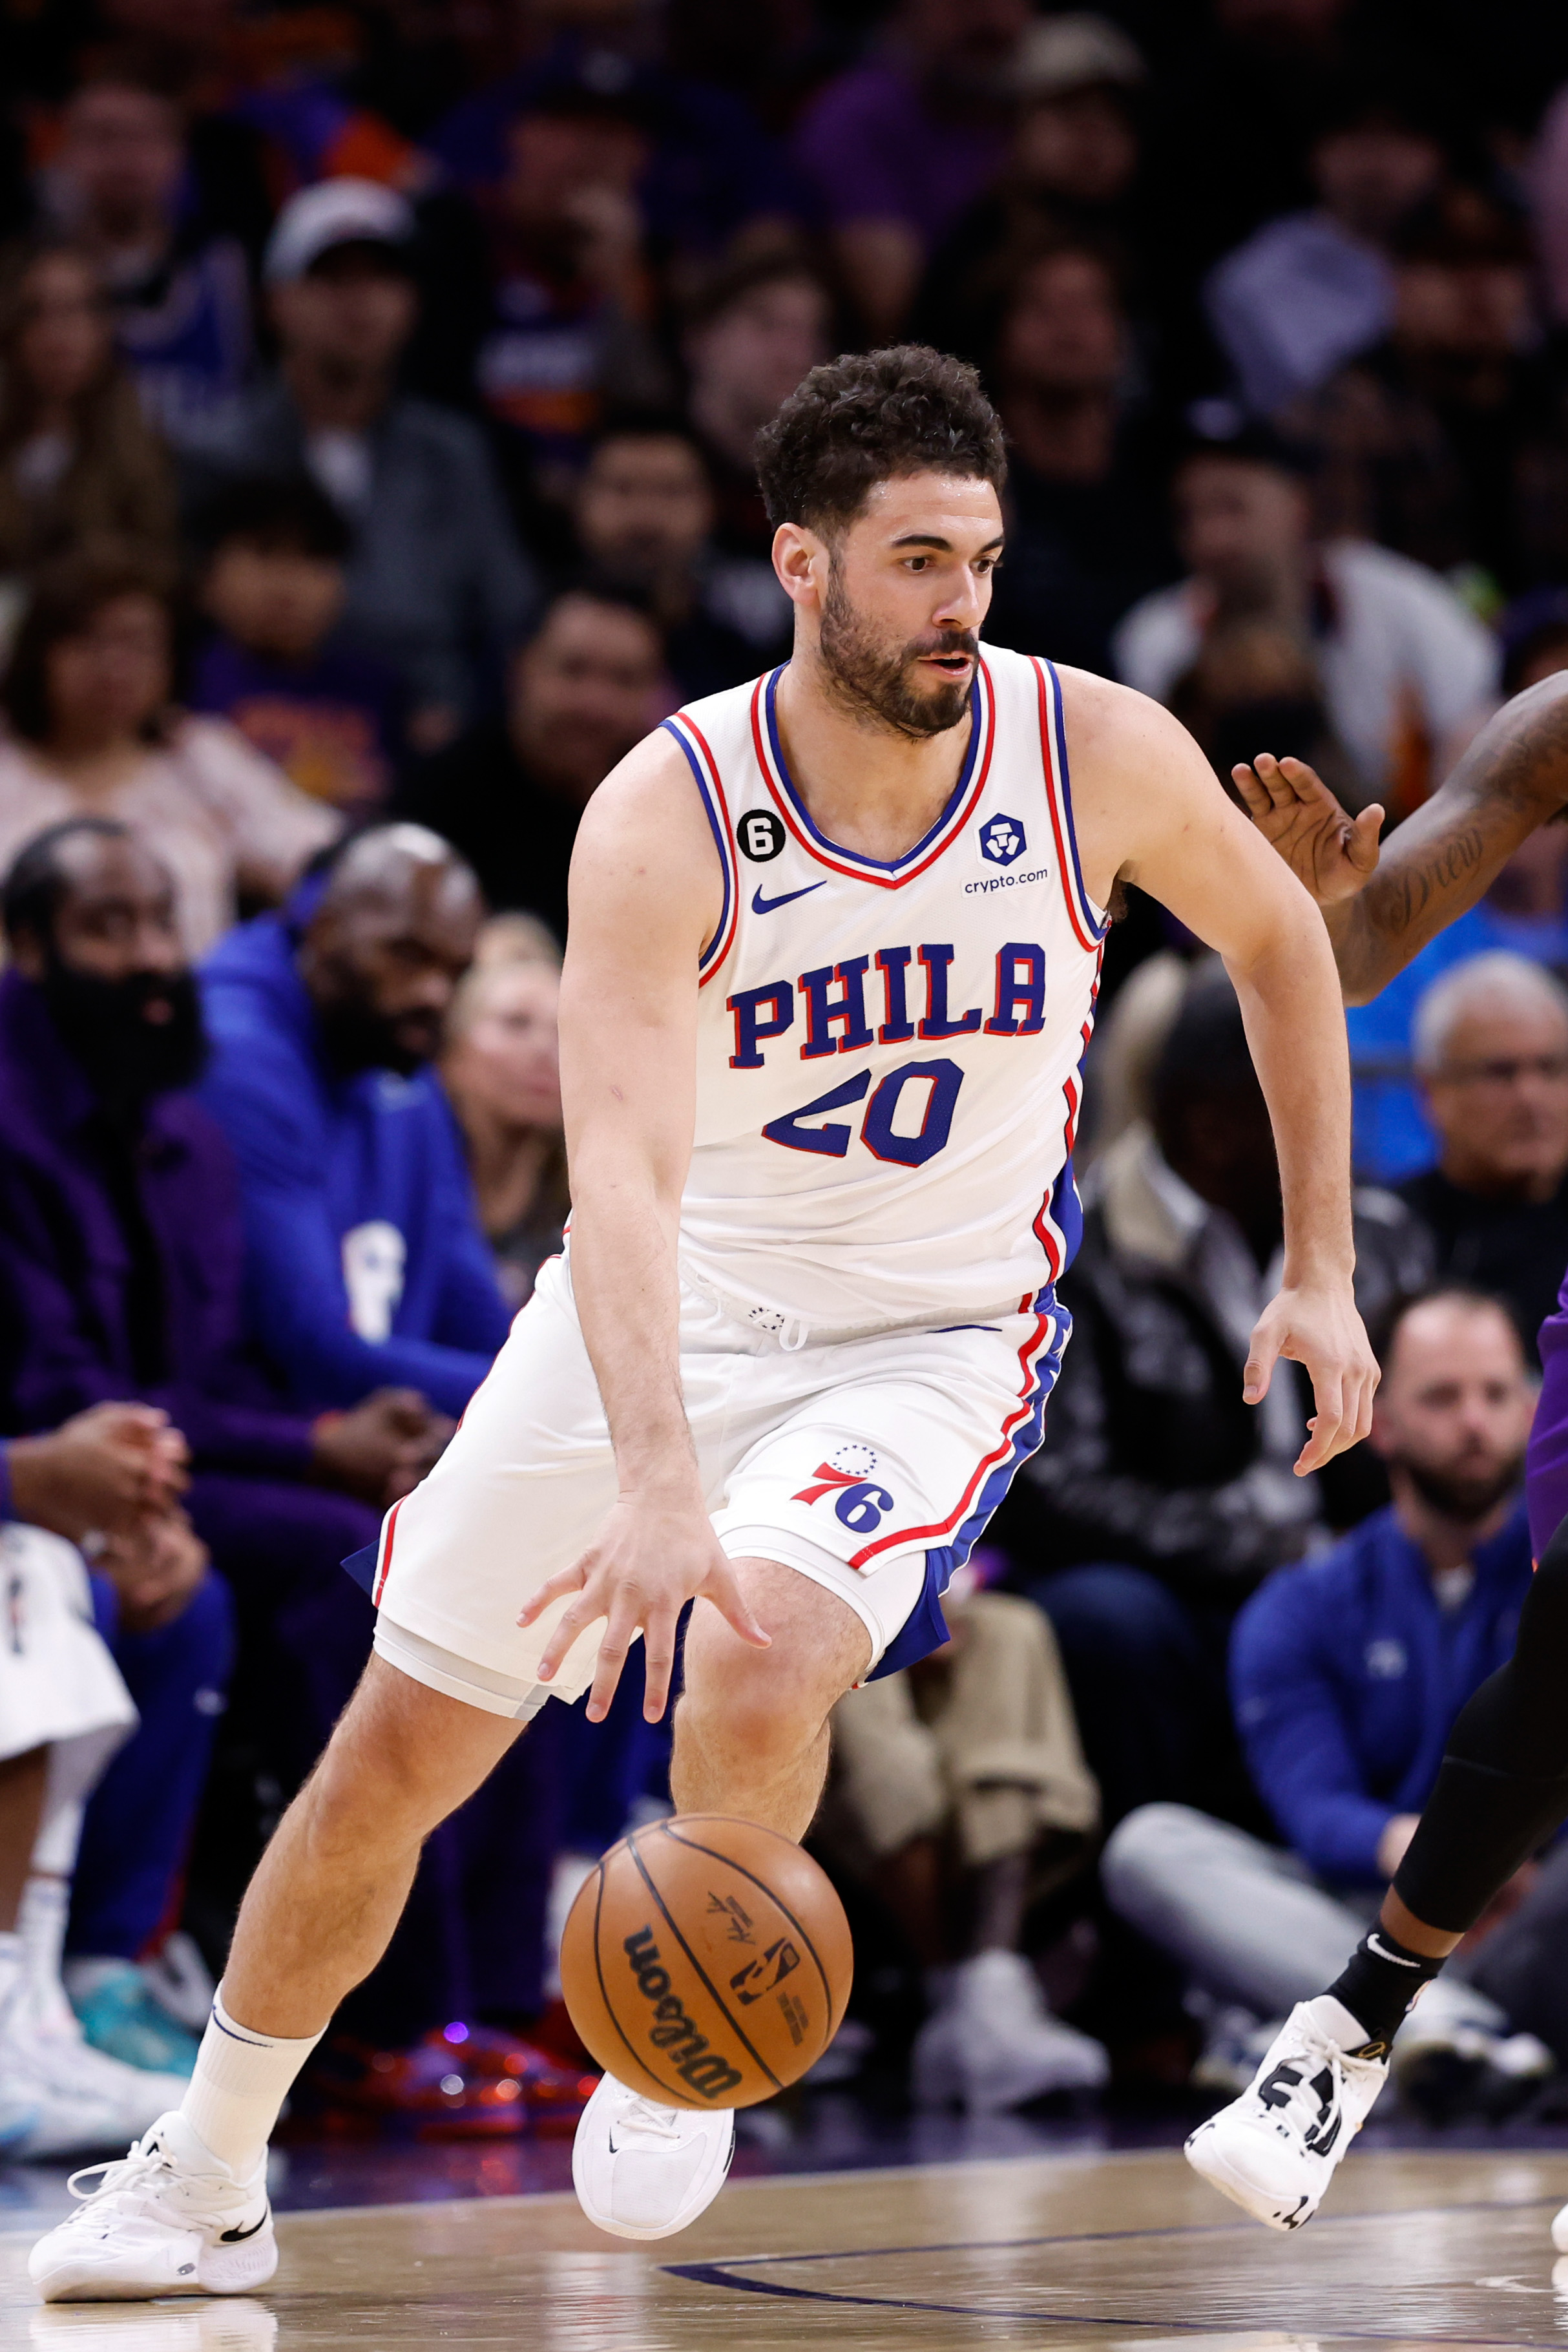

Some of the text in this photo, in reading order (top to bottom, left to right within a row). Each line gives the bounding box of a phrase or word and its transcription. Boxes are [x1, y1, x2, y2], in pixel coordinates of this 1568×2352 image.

[747, 817, 774, 856] 6
[964, 866, 1048, 894] crypto.com
[726, 942, 1047, 1069] PHILA
[789, 1462, 894, 1533] 76
[623, 1923, 743, 2099] Wilson
